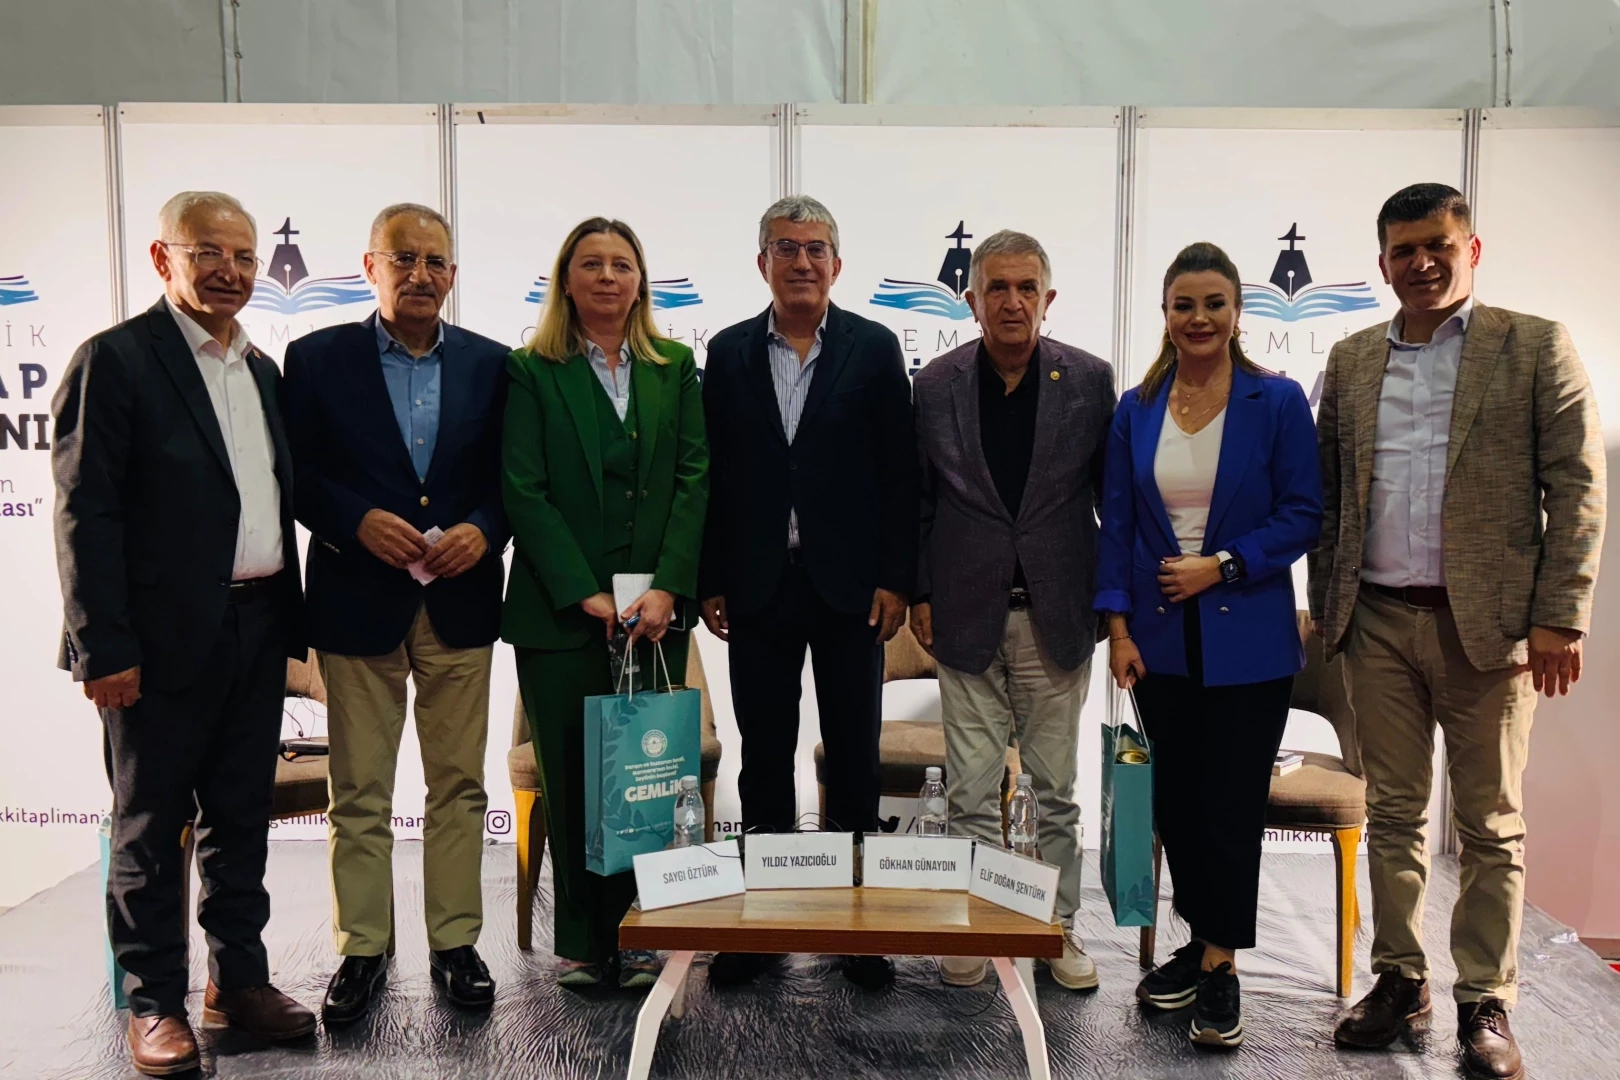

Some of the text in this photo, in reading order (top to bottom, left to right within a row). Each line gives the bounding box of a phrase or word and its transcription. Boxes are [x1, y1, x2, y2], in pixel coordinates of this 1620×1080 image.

[0, 363, 48, 399] P
[762, 855, 837, 868] YILDIZ YAZICIOĞLU
[879, 856, 956, 872] GÖKHAN GÜNAYDIN
[663, 865, 719, 884] SAYGI ÖZTÜRK
[979, 868, 1047, 901] ELİF DOĞAN ŞENTÜRK
